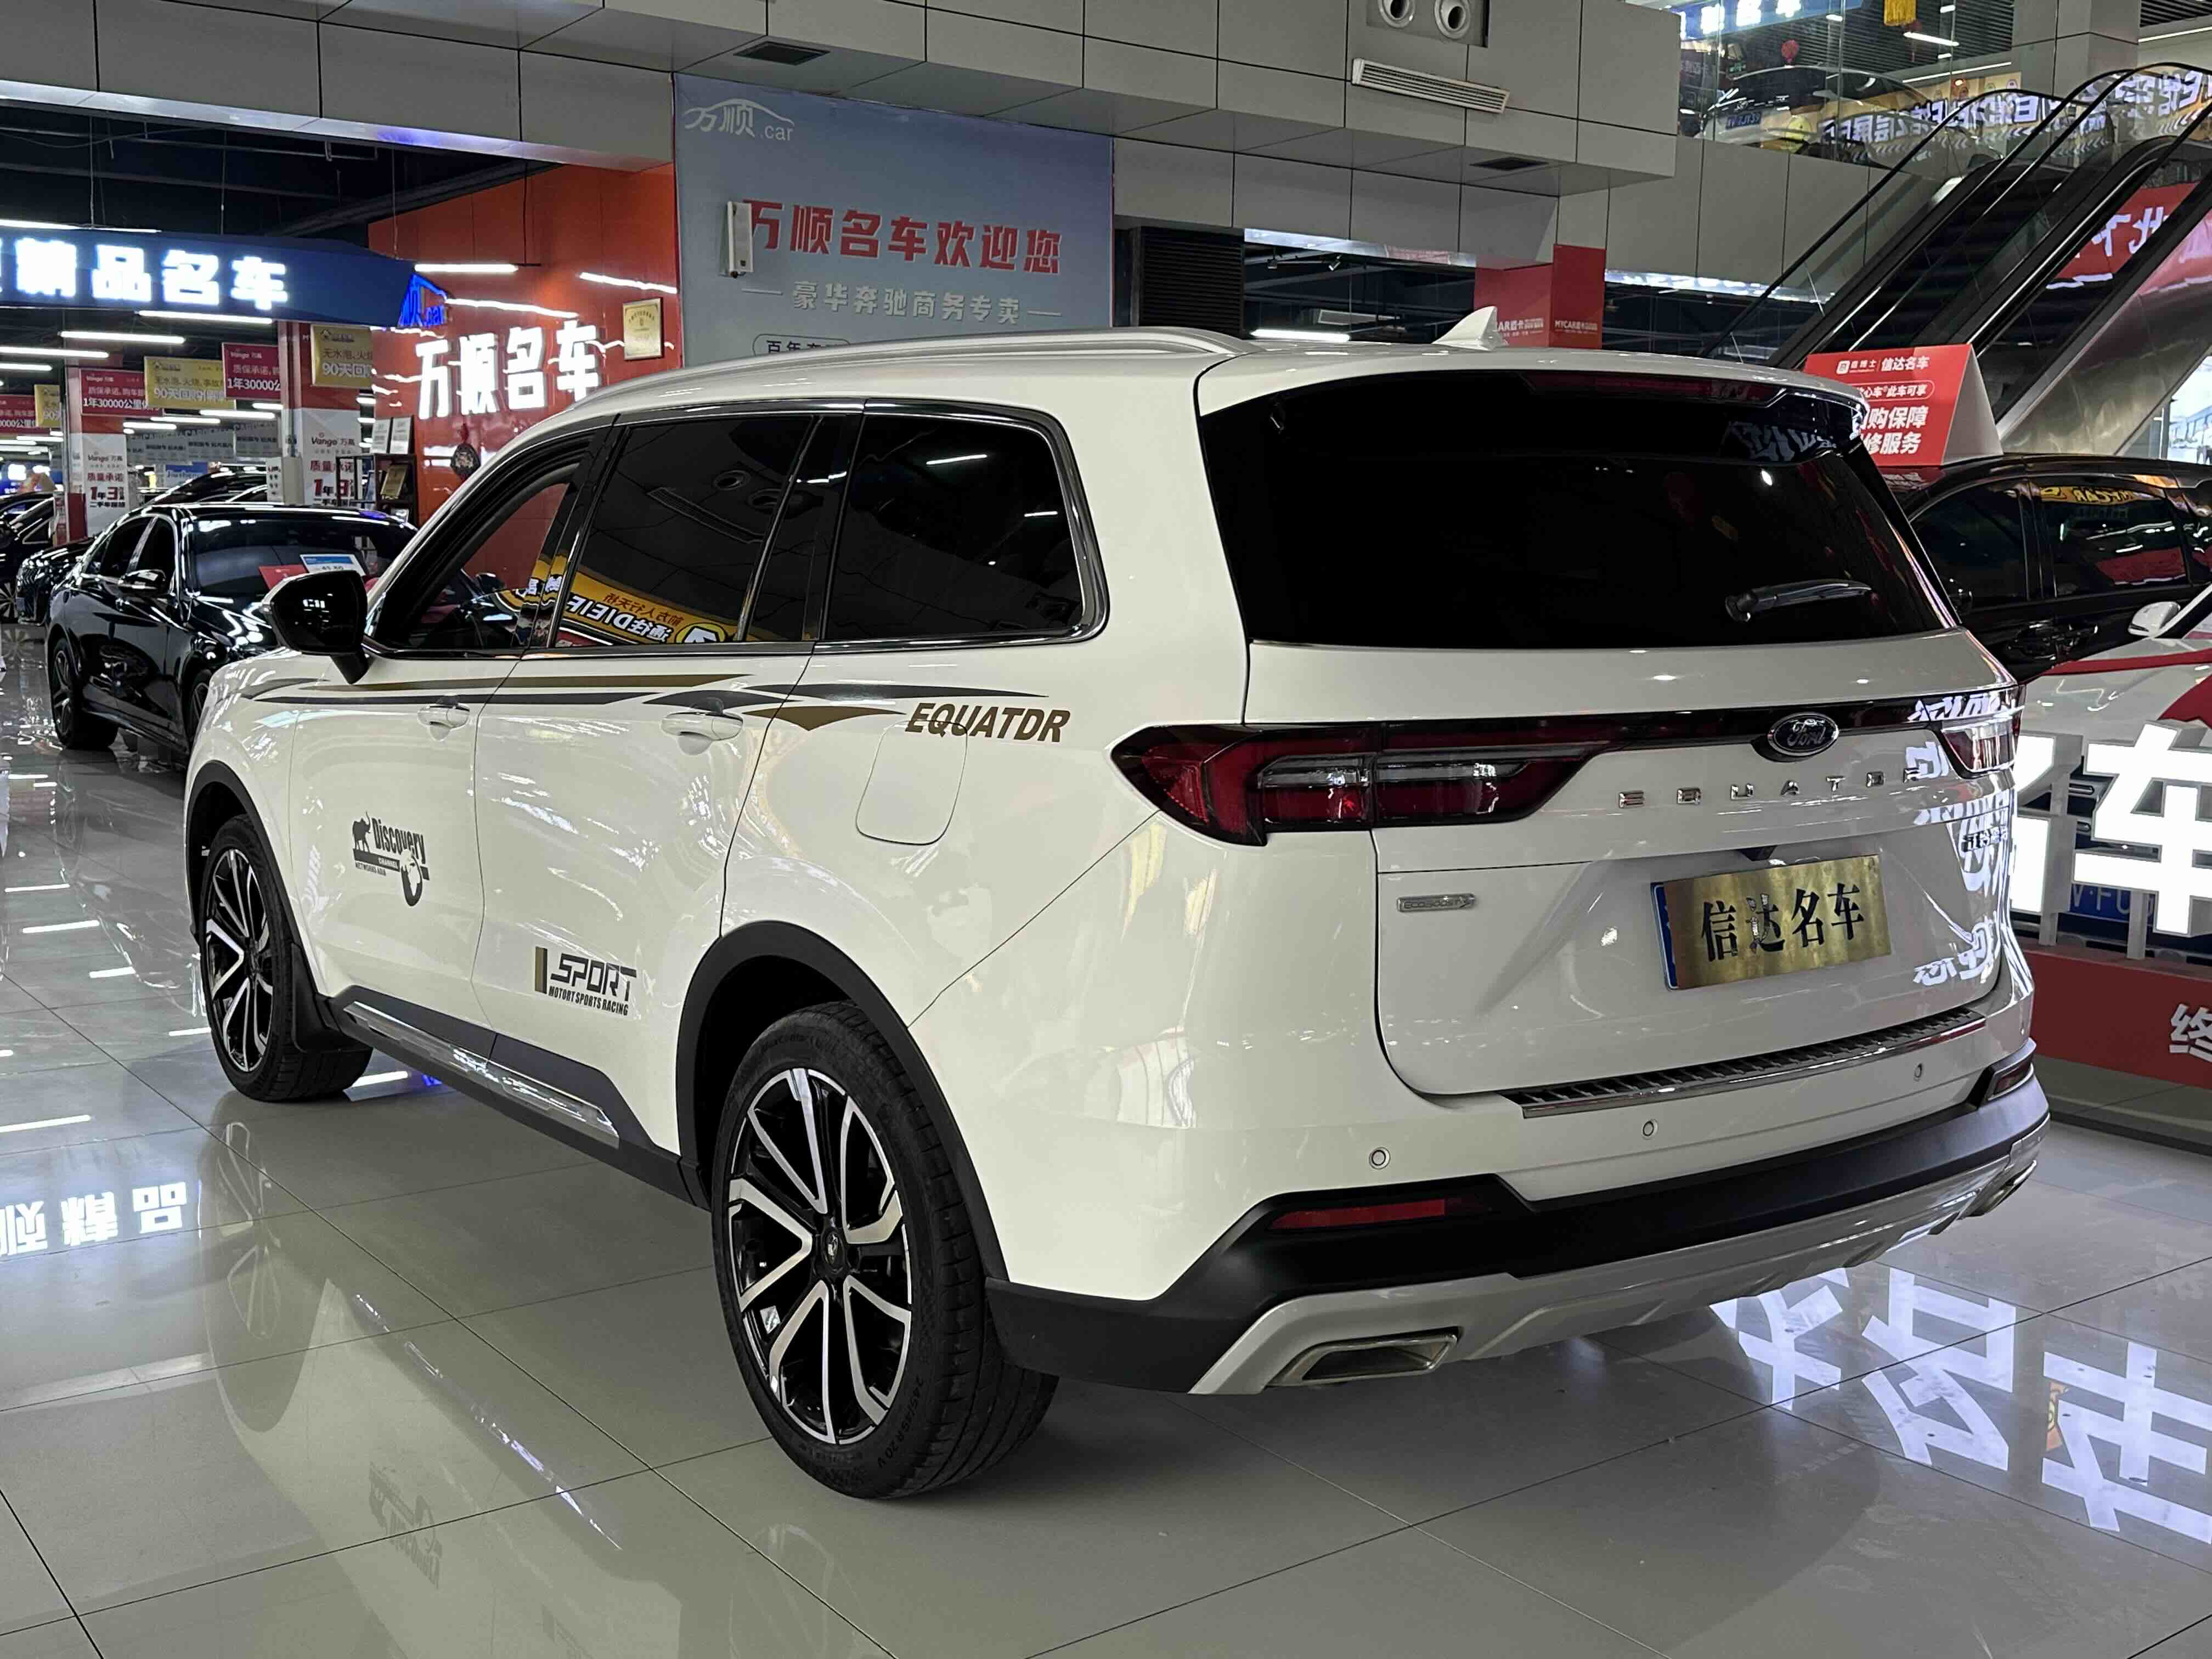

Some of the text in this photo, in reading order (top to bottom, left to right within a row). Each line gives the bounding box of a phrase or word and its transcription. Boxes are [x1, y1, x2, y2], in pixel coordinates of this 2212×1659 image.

[743, 198, 1062, 274] 万顺名车欢迎您
[0, 237, 288, 311] 精品名车
[792, 280, 1020, 325] 豪华奔驰商务专卖
[415, 320, 600, 419] 万顺名车
[1881, 356, 1930, 372] 信达名车
[1861, 431, 1922, 455] 修服务
[1701, 882, 1865, 962] 信达名车
[550, 952, 637, 1002] SPORT
[575, 991, 602, 1009] SPORTS
[601, 998, 628, 1016] RACING
